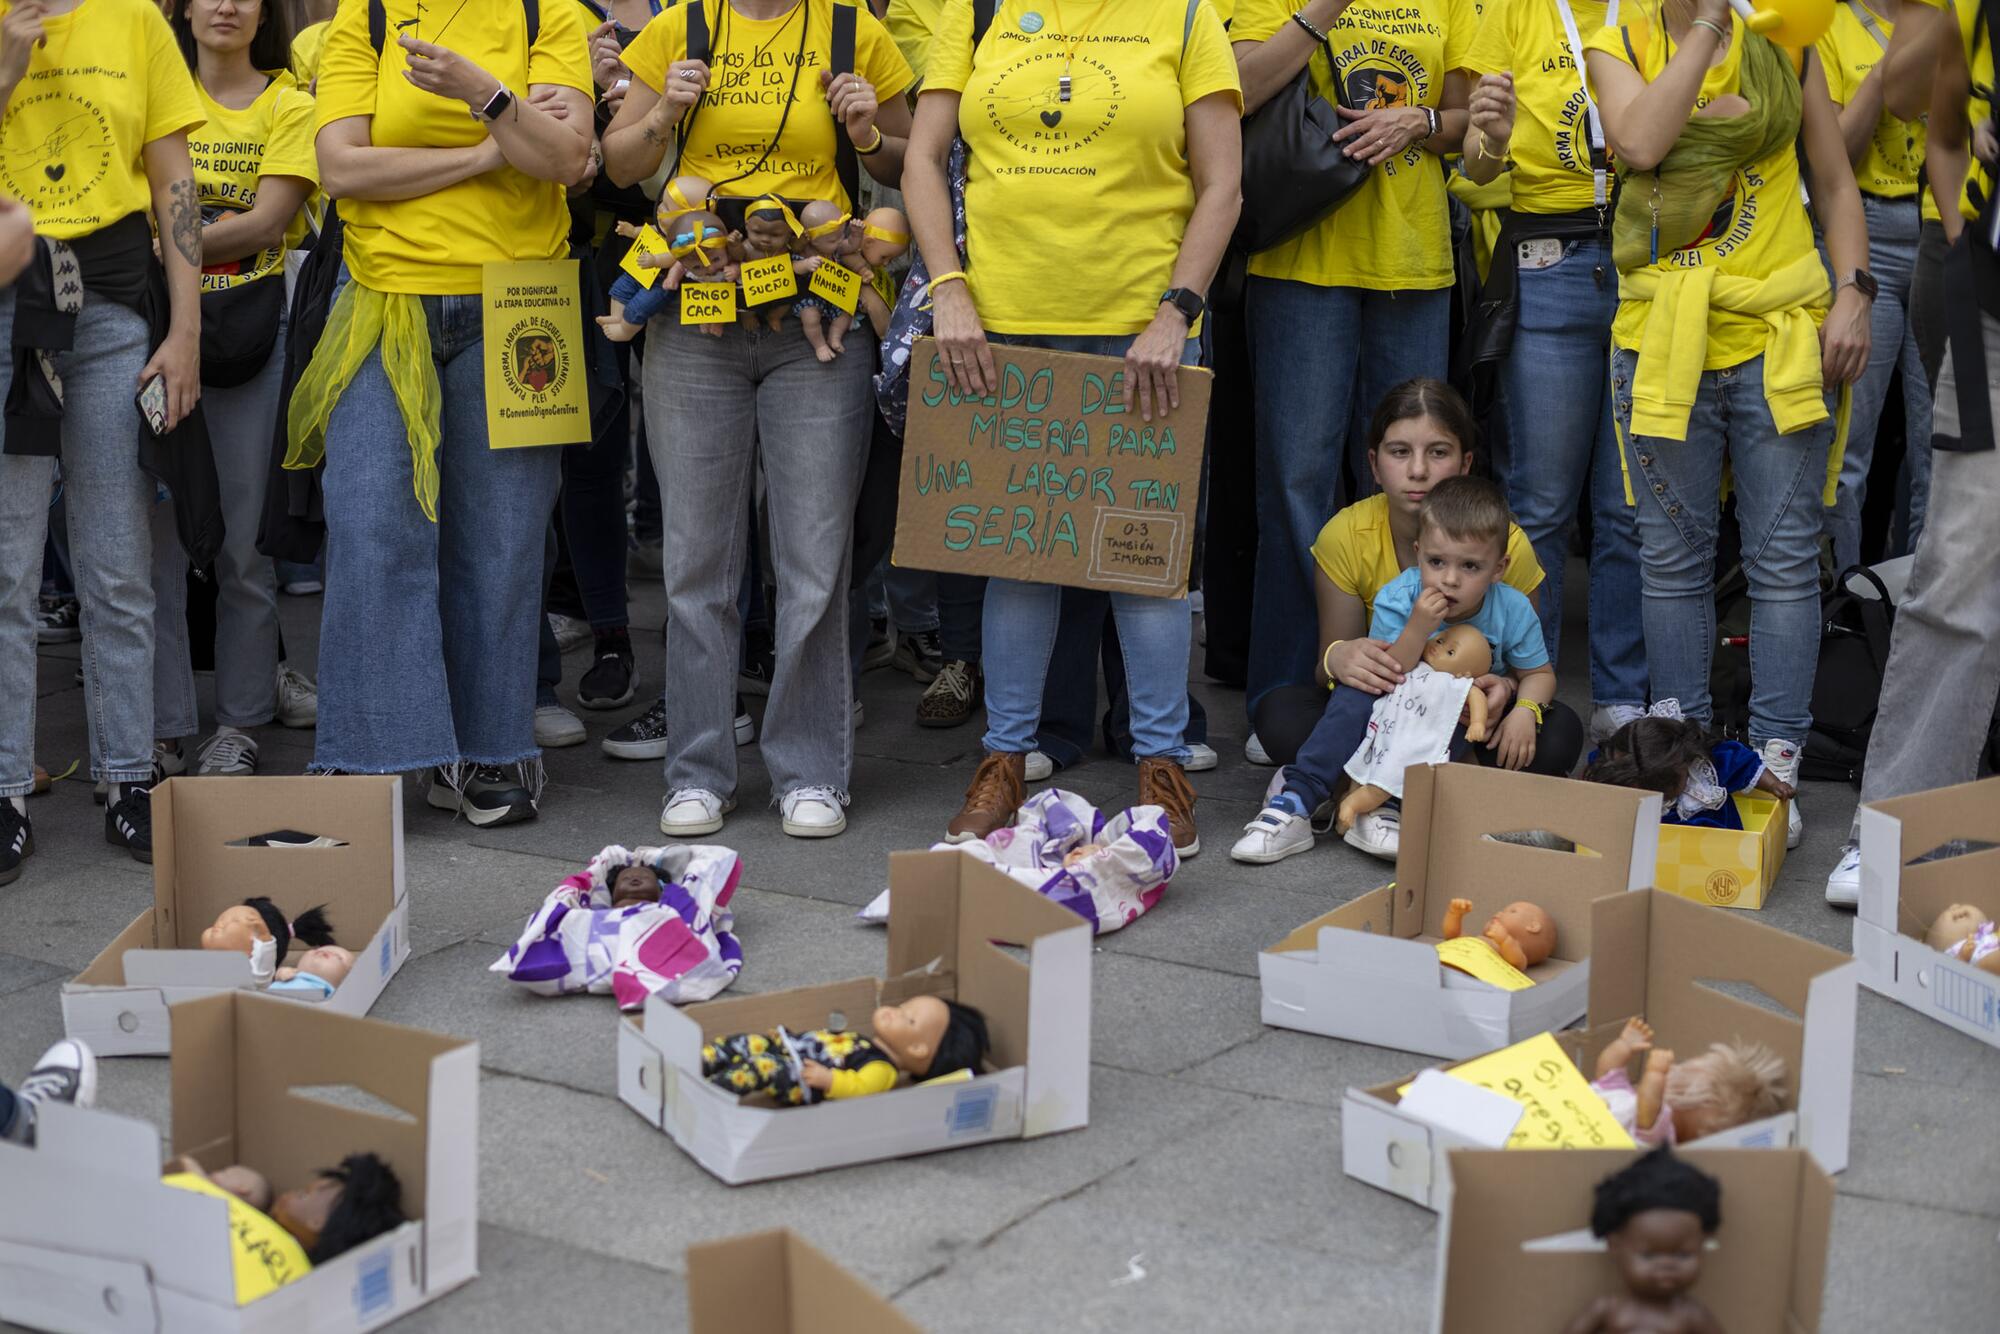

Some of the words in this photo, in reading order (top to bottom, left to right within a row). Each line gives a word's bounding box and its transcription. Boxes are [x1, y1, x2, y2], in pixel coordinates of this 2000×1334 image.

[1332, 17, 1356, 30] APA
[1359, 18, 1426, 35] EDUCATIVA
[1103, 35, 1150, 44] INFANCIA
[1335, 41, 1369, 71] ORAL
[1371, 39, 1387, 55] DE
[1389, 45, 1428, 99] ESCUELAS
[1542, 58, 1556, 72] LA
[1559, 56, 1577, 71] ETA
[30, 71, 50, 81] VOZ
[51, 68, 64, 77] DE
[82, 66, 127, 79] INFANCIA
[1083, 56, 1121, 96] LABORAL
[1559, 86, 1587, 126] LABO
[69, 93, 111, 142] LABORAL
[987, 103, 1038, 154] ESCUELAS
[1046, 104, 1119, 154] INFANTILES
[1034, 131, 1067, 140] PLEI
[213, 142, 265, 156] DIGNIFIC
[213, 159, 260, 174] EDUCAT
[1014, 166, 1026, 175] ES
[1029, 165, 1096, 176] EDUCACIÓN
[52, 151, 110, 209] INFANTILES
[40, 185, 71, 194] PLEI
[221, 183, 238, 198] DE
[1714, 194, 1757, 257] NFANTILES
[1670, 250, 1703, 266] PLEI
[201, 274, 231, 289] PLEI
[506, 287, 520, 297] POR
[521, 285, 558, 296] DIGNIFICAR
[494, 299, 503, 309] LA
[504, 298, 523, 309] ETAPA
[524, 297, 559, 308] EDUCATIVA
[560, 296, 571, 306] 0-3
[686, 305, 722, 317] CACA
[530, 316, 539, 326] DE
[504, 318, 528, 349] LABORAL
[540, 317, 567, 350] ESCUELAS
[502, 351, 526, 400] PLATAFORMA
[551, 351, 569, 396] INFANTILES
[532, 392, 547, 404] PLEI
[1107, 423, 1177, 459] PARA
[914, 453, 973, 497] UNA
[1006, 462, 1116, 505] LABOR
[1129, 478, 1180, 512] TAN
[1111, 552, 1166, 567] IMPORTA
